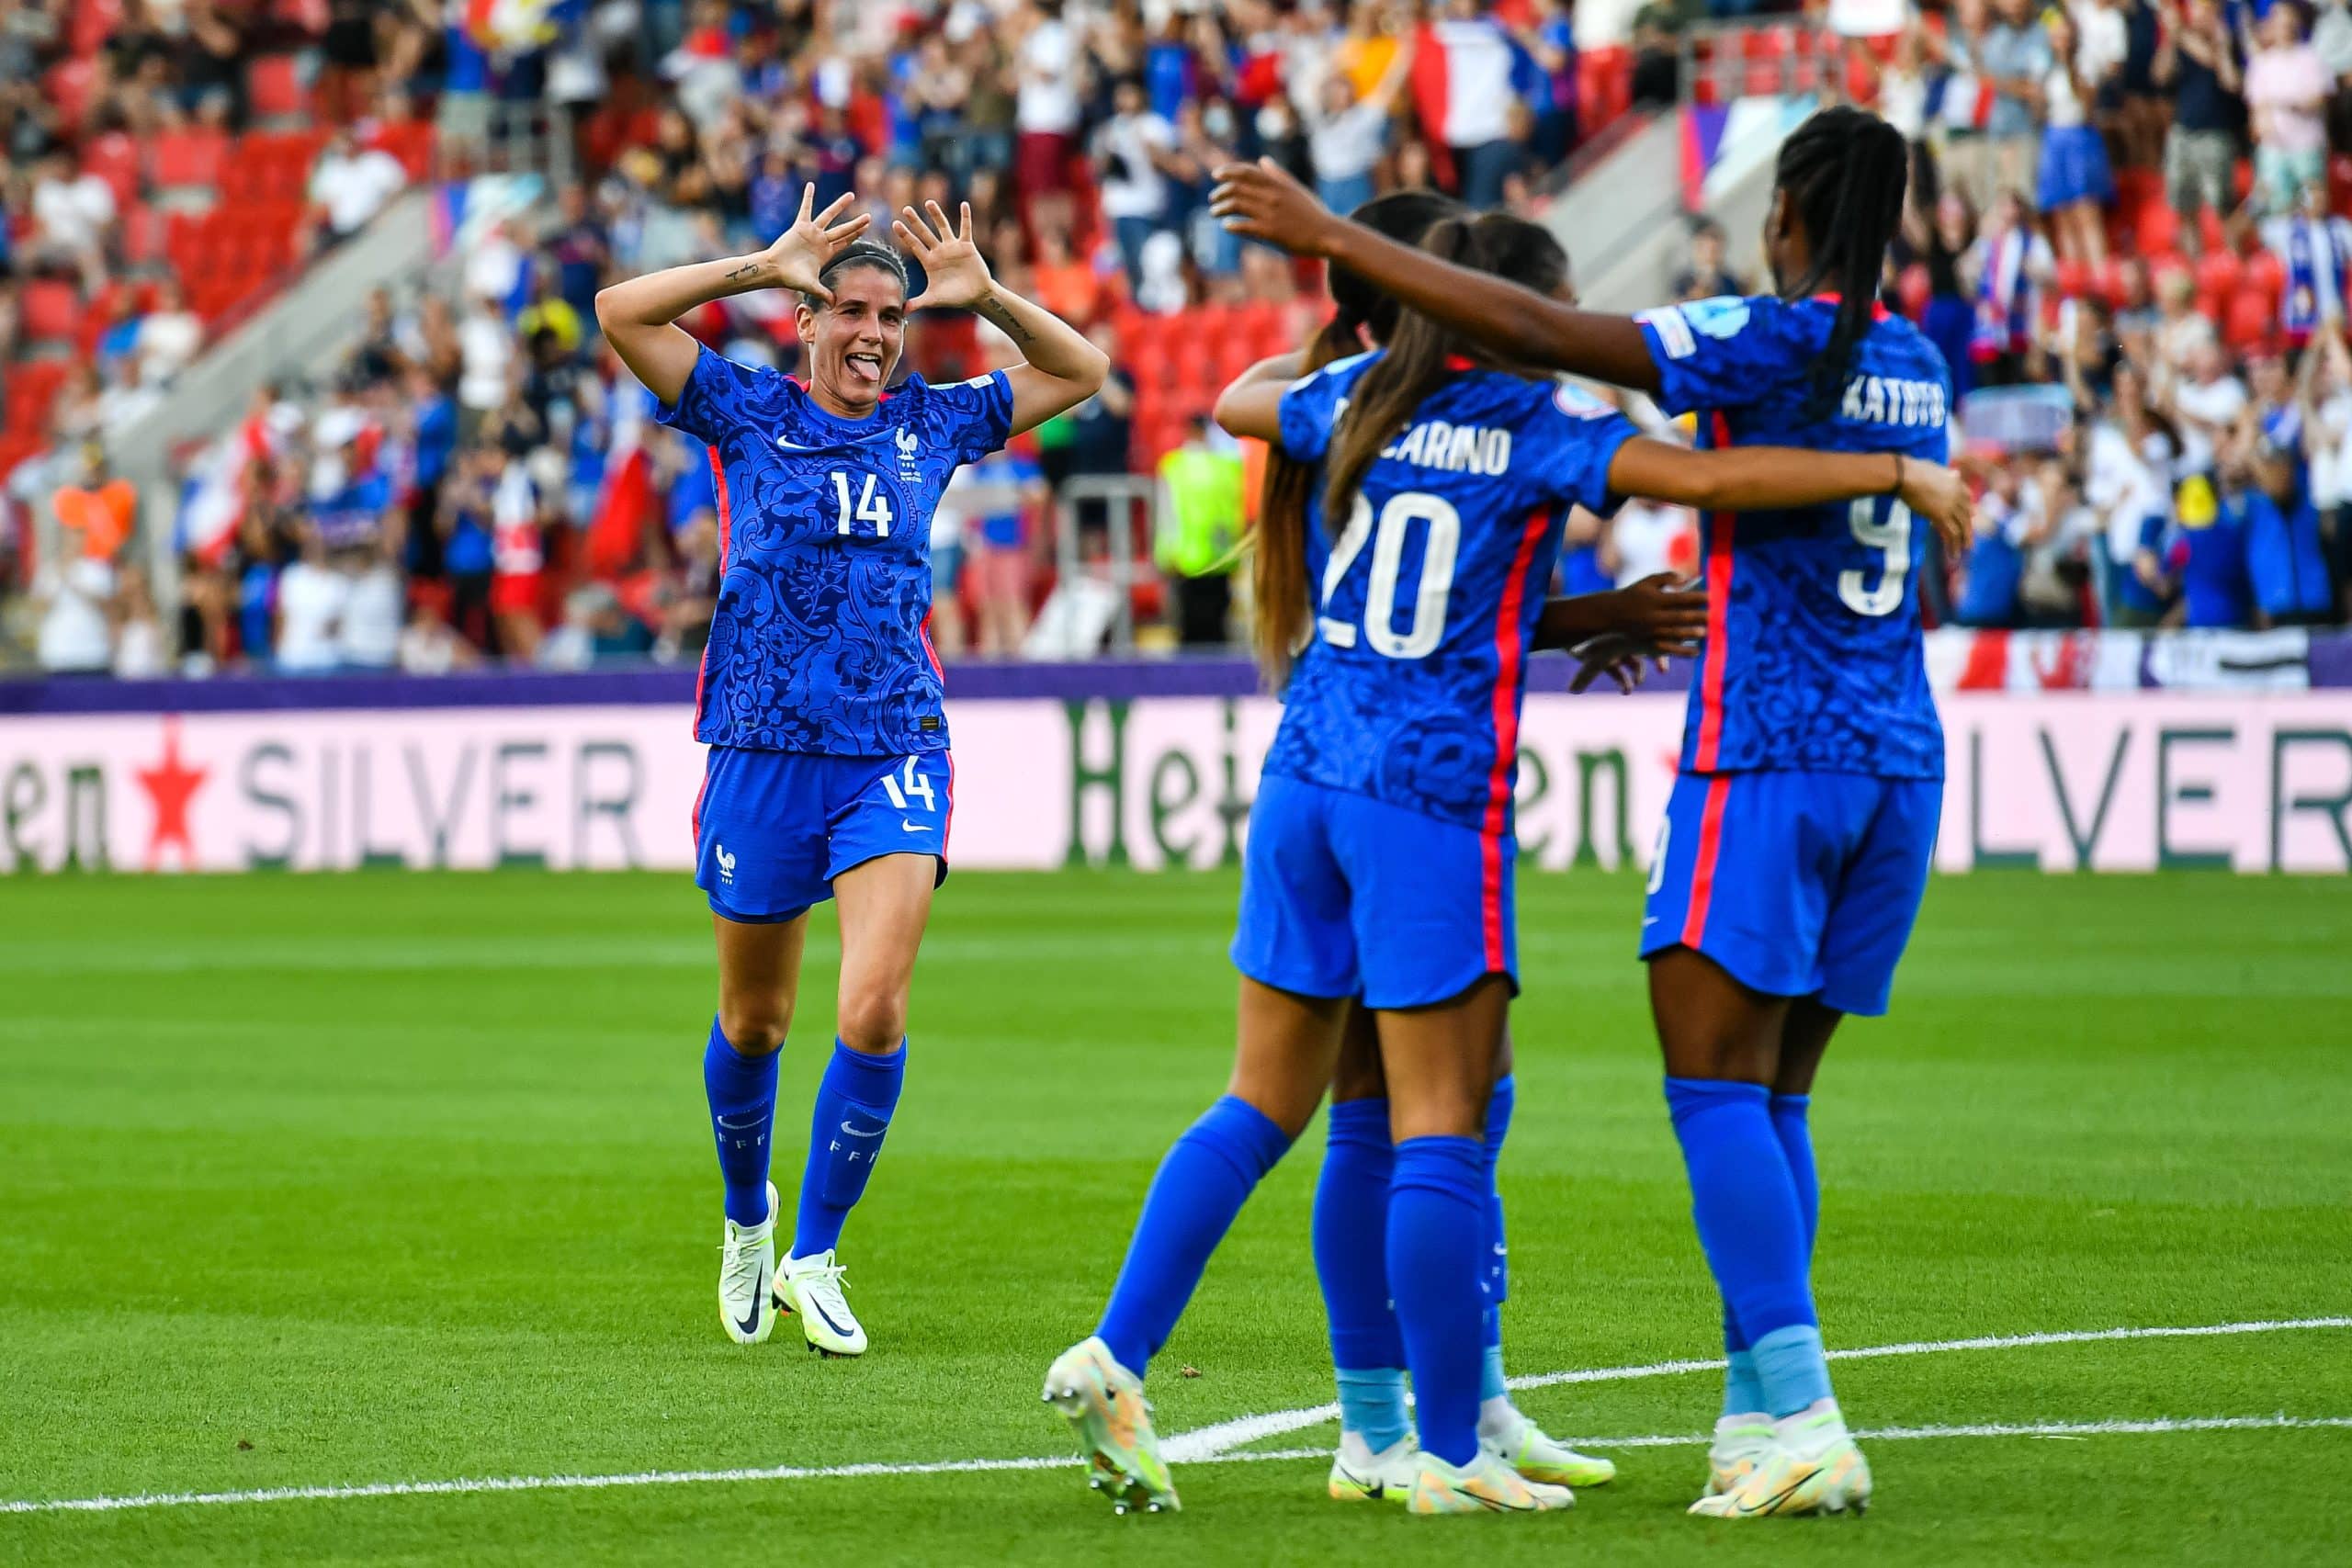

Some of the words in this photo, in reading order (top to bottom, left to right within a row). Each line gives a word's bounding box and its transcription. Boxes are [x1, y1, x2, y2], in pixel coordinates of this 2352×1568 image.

[831, 471, 893, 537] 14
[1838, 497, 1911, 617] 9
[1318, 491, 1461, 660] 20
[236, 738, 656, 871] SILVER
[879, 755, 935, 812] 14
